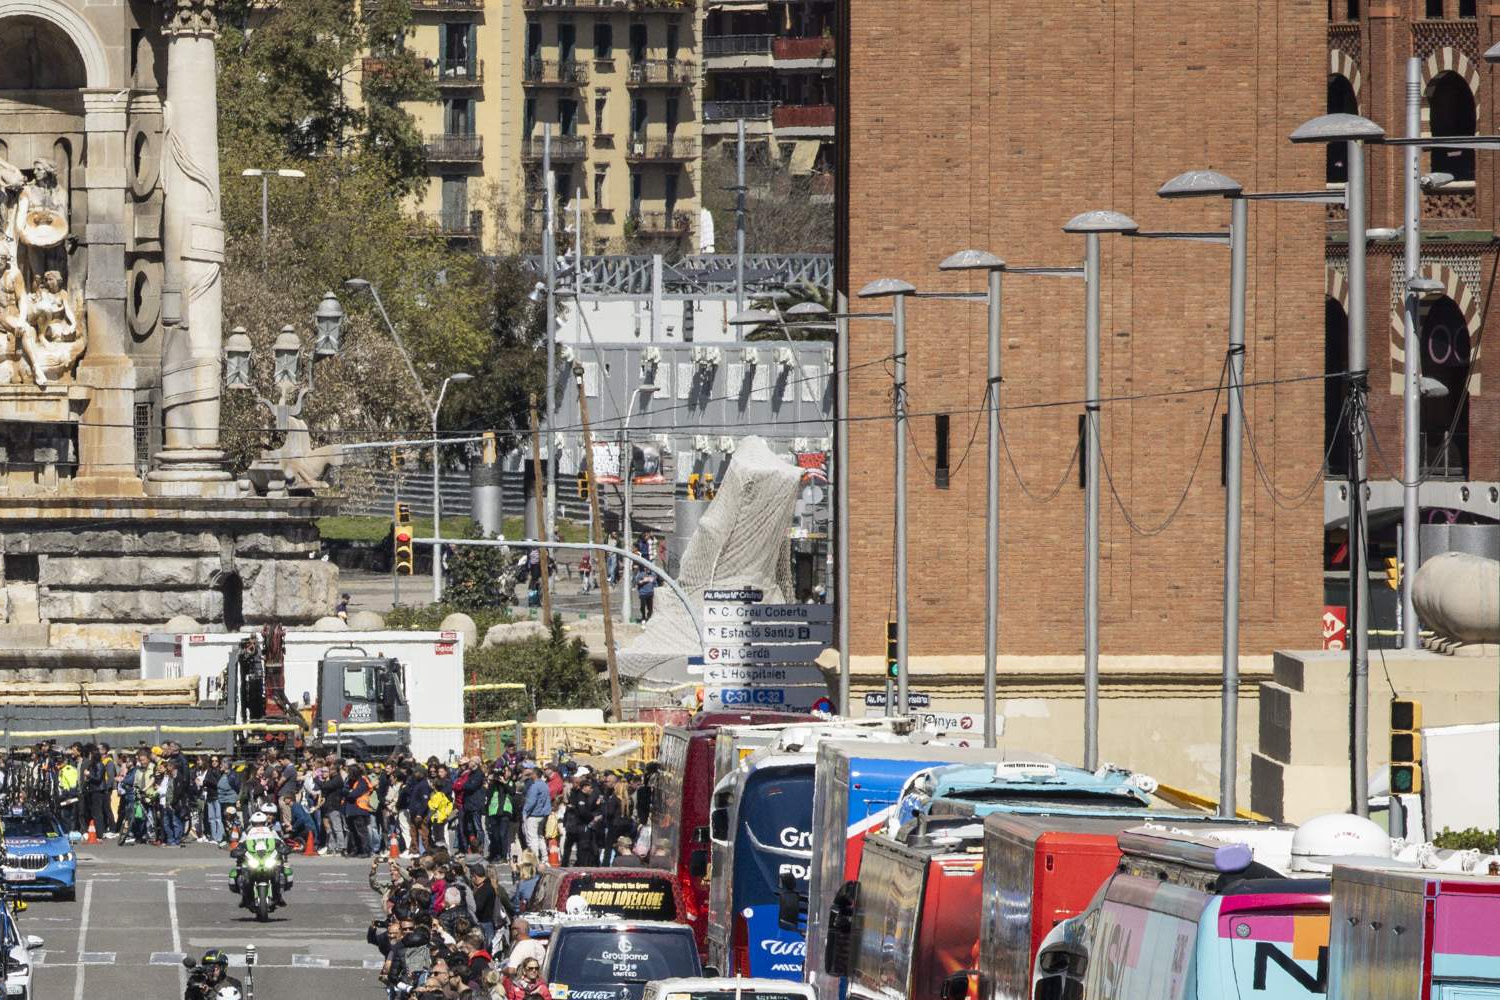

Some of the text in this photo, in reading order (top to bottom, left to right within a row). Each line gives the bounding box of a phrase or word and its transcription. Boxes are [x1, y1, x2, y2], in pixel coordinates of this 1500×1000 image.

[736, 606, 761, 617] Creu
[764, 606, 808, 618] Coberta
[721, 626, 795, 639] Estació Sants
[726, 691, 748, 701] C-31
[602, 951, 649, 961] Groupama
